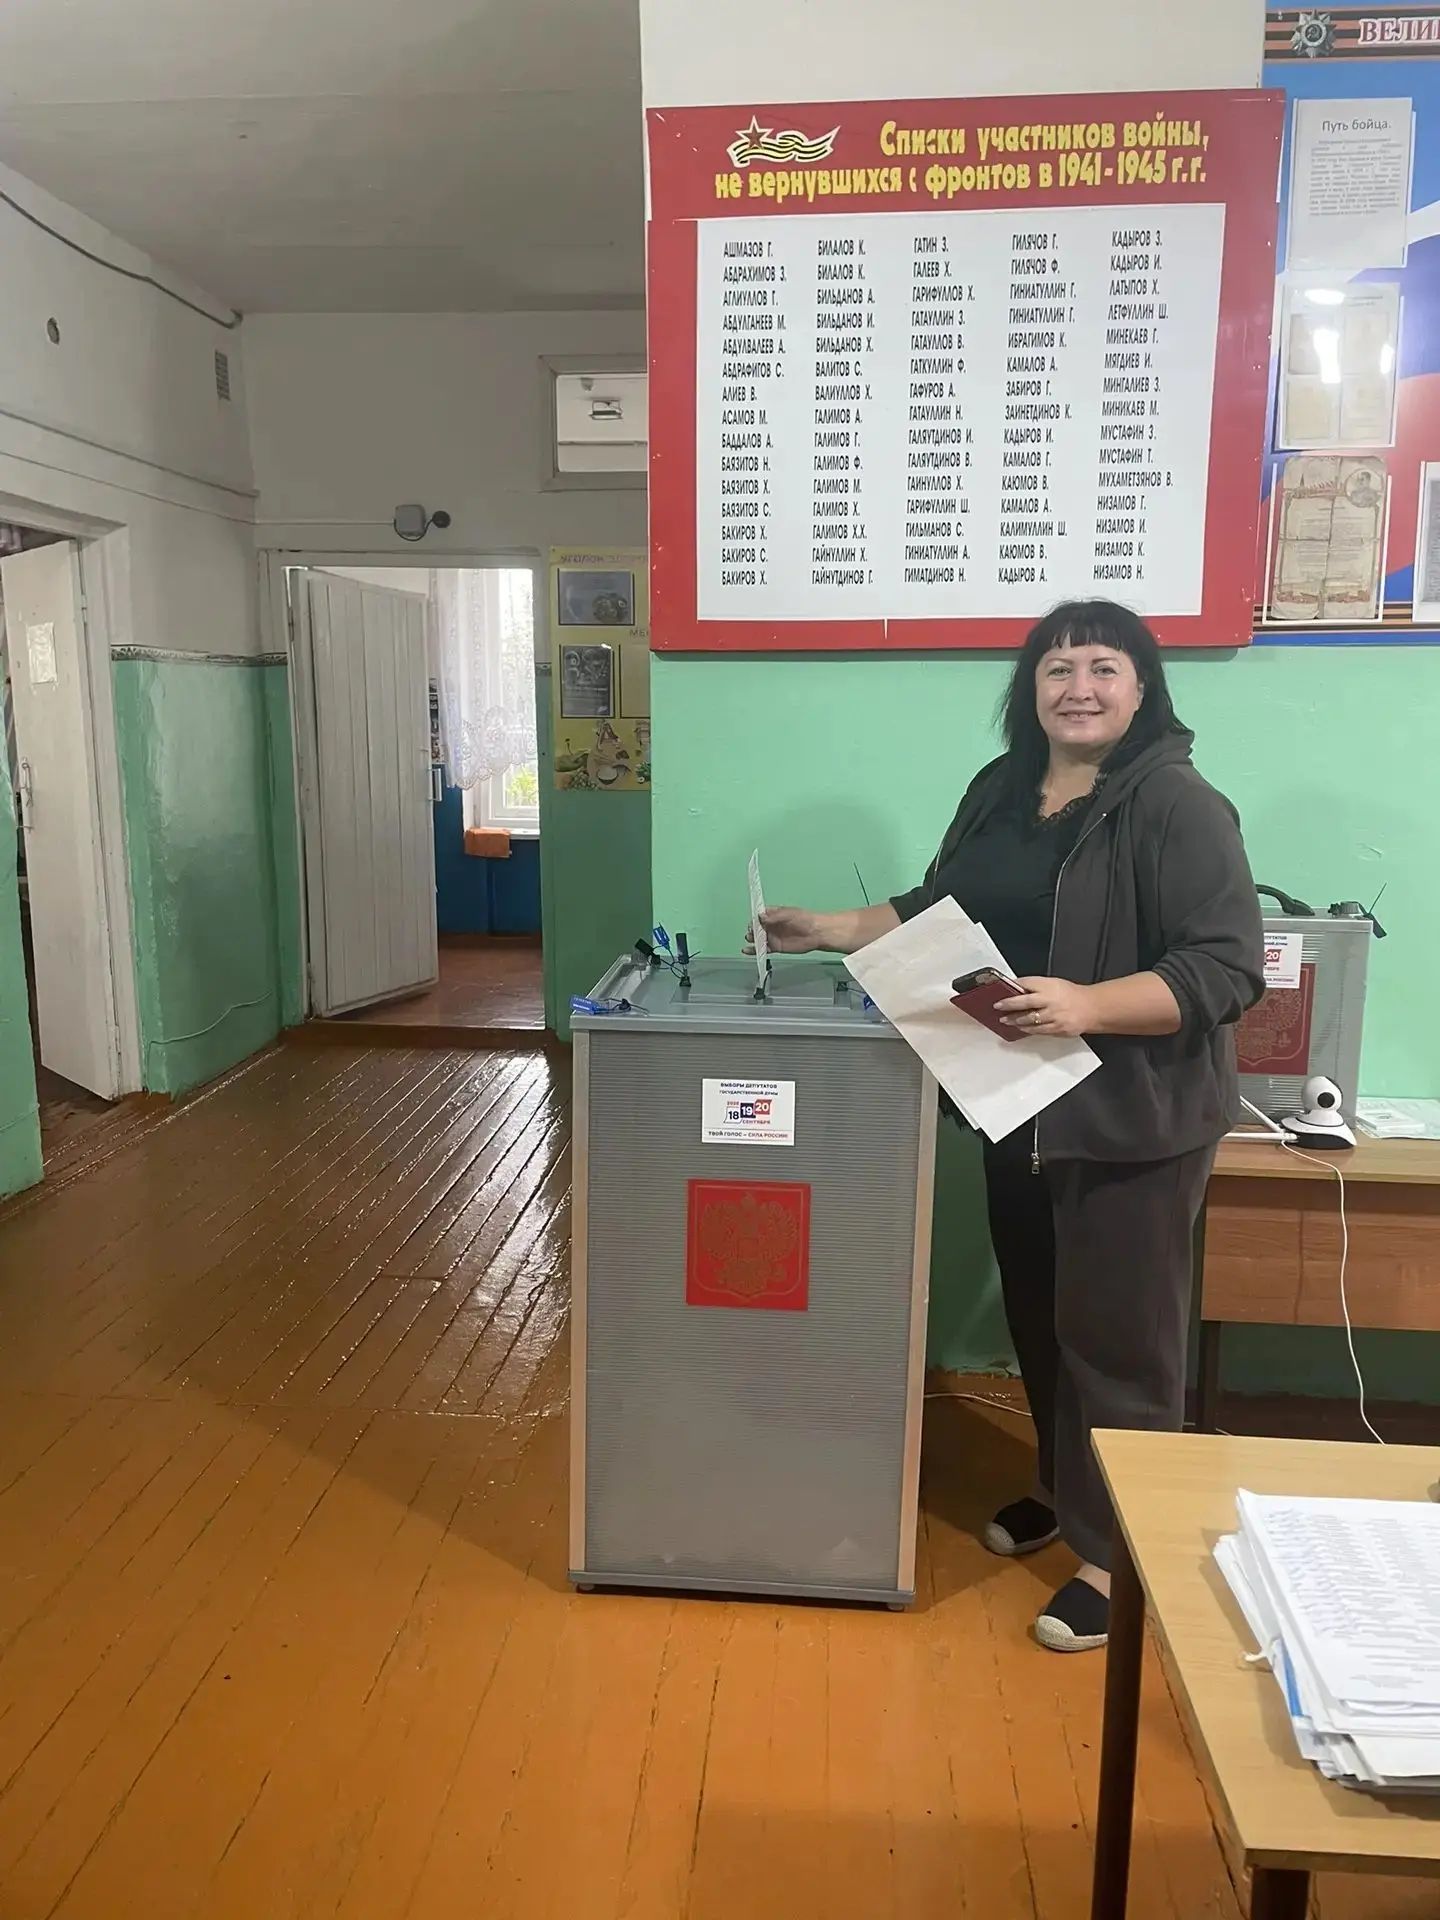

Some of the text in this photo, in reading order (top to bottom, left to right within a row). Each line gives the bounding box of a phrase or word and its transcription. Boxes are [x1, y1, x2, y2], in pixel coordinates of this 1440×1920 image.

[1360, 19, 1440, 42] ВЕЛИ
[1322, 118, 1392, 134] Путь бойца.
[880, 111, 1209, 161] Списки участников войны,
[715, 171, 744, 199] не
[748, 166, 902, 204] вернувшихся
[909, 167, 917, 192] с
[925, 163, 1031, 200] фронтов
[1039, 162, 1052, 188] в
[914, 236, 948, 253] ГАТИН З.
[1112, 230, 1162, 249] КАДЫРОВ З.
[818, 240, 865, 256] БИЛАЛОВ К.
[913, 261, 952, 277] ГАЛЕЕВ Х.
[1011, 258, 1060, 275] ГИЛЯЧОВ Ф.
[1111, 254, 1162, 273] КАДЫРОВ И.
[723, 266, 786, 284] АБДРАХИМОВ З.
[818, 264, 865, 280] БИЛАЛОВ К.
[913, 285, 975, 302] ГАРИФУЛЛОВ Х.
[1109, 279, 1159, 295] ЛАТЫПОВ Х.
[817, 288, 875, 306] БИЛЬДАНОВ А.
[912, 310, 965, 326] ГАТАУЛЛИН З.
[1108, 304, 1168, 320] ЛЕТФУЛЛИН Ш.
[723, 315, 786, 333] АБДУЛГАНЕЕВ М.
[817, 313, 875, 331] БИЛЬДАНОВ И.
[723, 339, 786, 357] АБДУЛВАЛЕЕВ А.
[816, 337, 873, 355] БИЛЬДАНОВ Х.
[911, 334, 964, 350] ГАТАУЛЛОВ В.
[1008, 332, 1066, 348] ИБРАГИМОВ К.
[722, 362, 784, 380] АБДРАФИГОВ С.
[816, 361, 862, 377] ВАЛИТОВ С.
[1007, 356, 1057, 372] КАМАЛОВ А.
[815, 384, 872, 400] ВАЛИУЛЛОВ Х.
[910, 382, 955, 398] ГАФУРОВ А.
[1103, 377, 1160, 392] МИНГАЛИЕВ З.
[722, 386, 757, 401] АЛИЕВ В.
[909, 405, 963, 421] ГАТАУЛЛИН Н.
[1005, 404, 1072, 422] ЗАИНЕТДИНОВ К.
[1102, 400, 1159, 416] МИНИКАЕВ М.
[722, 410, 768, 425] АСАМОВ М.
[815, 409, 862, 424] ГАЛИМОВ А.
[909, 428, 973, 446] ГАЛЯУТДИНОВ И.
[1004, 428, 1053, 446] КАДЫРОВ И.
[1101, 424, 1156, 440] МУСТАФИН З.
[722, 433, 773, 451] БАДДАЛОВ А.
[722, 456, 770, 471] БАЯЗИТОВ Н.
[814, 455, 863, 470] ГАЛИМОВ Ф.
[908, 452, 972, 469] ГАЛЯУТДИНОВ В.
[722, 479, 770, 495] БАЯЗИТОВ Х.
[814, 479, 862, 494] ГАЛИМОВ М.
[908, 475, 963, 491] ГАИНУЛЛОВ Х.
[1002, 475, 1048, 490] КАЮМОВ В.
[1099, 472, 1173, 487] МУХАМЕТЗЯНОВ В.
[722, 502, 771, 517] БАЯЗИТОВ С.
[813, 501, 860, 516] ГАЛИМОВ Х.
[907, 499, 970, 514] ГАРИФУЛЛИН Ш.
[1001, 498, 1051, 513] КАМАЛОВ А.
[722, 525, 767, 540] БАКИРОВ Х.
[813, 524, 867, 539] ГАЛИМОВ Х.Х.
[906, 522, 964, 537] ГИЛЬМАНОВ С.
[1000, 521, 1067, 536] КАЛИМУЛЛИН Ш.
[722, 548, 768, 563] БАКИРОВ С.
[812, 544, 867, 562] ГАЙНУЛЛИН Х.
[905, 545, 970, 560] ГИНИАТУЛЛИН А.
[999, 544, 1047, 559] КАЮМОВ В.
[1095, 541, 1144, 556] НИЗАМОВ К.
[722, 570, 767, 585] БАКИРОВ Х.
[905, 568, 966, 584] ГИМАТДИНОВ Н.
[998, 567, 1047, 584] КАДЫРОВ А.
[1093, 565, 1144, 579] НИЗАМОВ Н.
[1266, 951, 1279, 960] 20
[728, 1102, 770, 1120] 18 19 20
